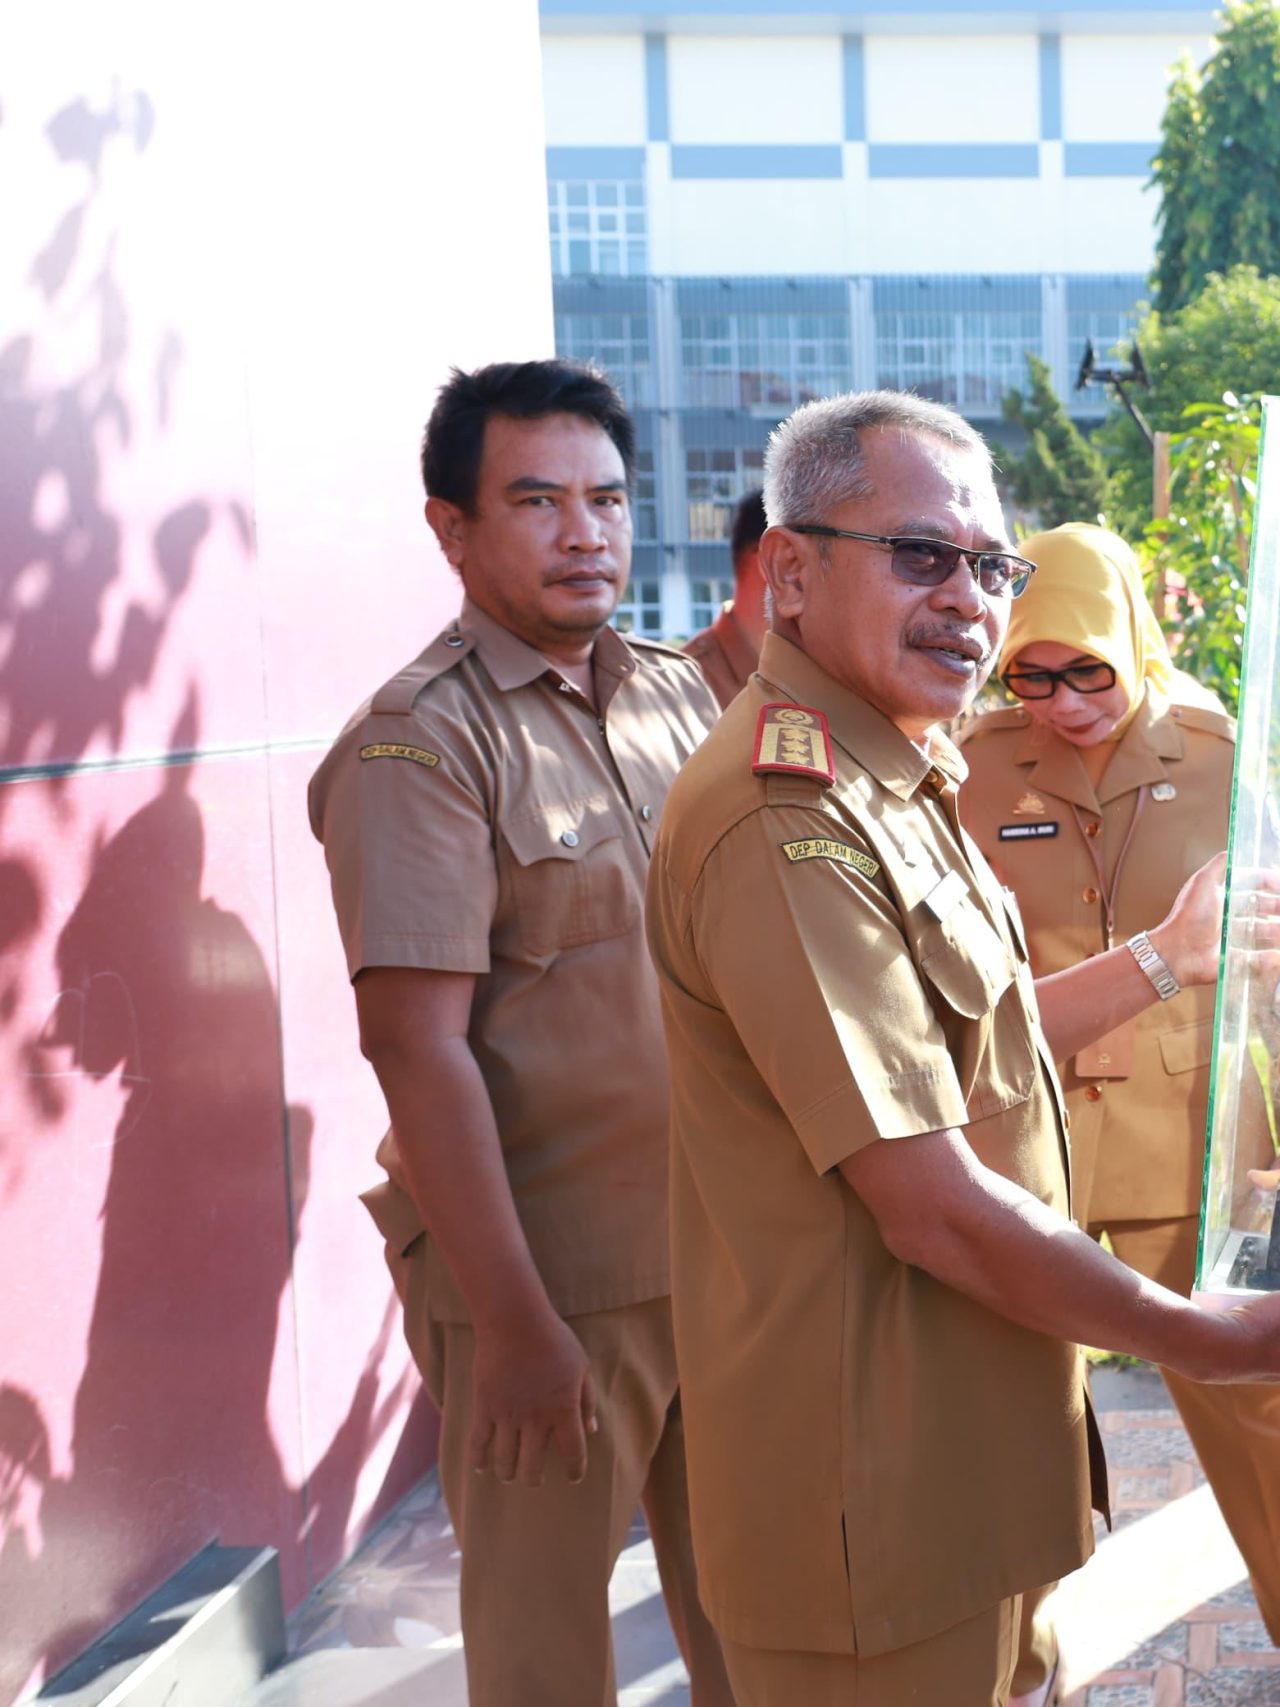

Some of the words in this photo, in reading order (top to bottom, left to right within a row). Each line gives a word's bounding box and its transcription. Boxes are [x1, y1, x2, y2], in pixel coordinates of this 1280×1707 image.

[789, 842, 811, 859] DEP
[815, 841, 847, 858] DALAM
[849, 850, 877, 874] NEGERI
